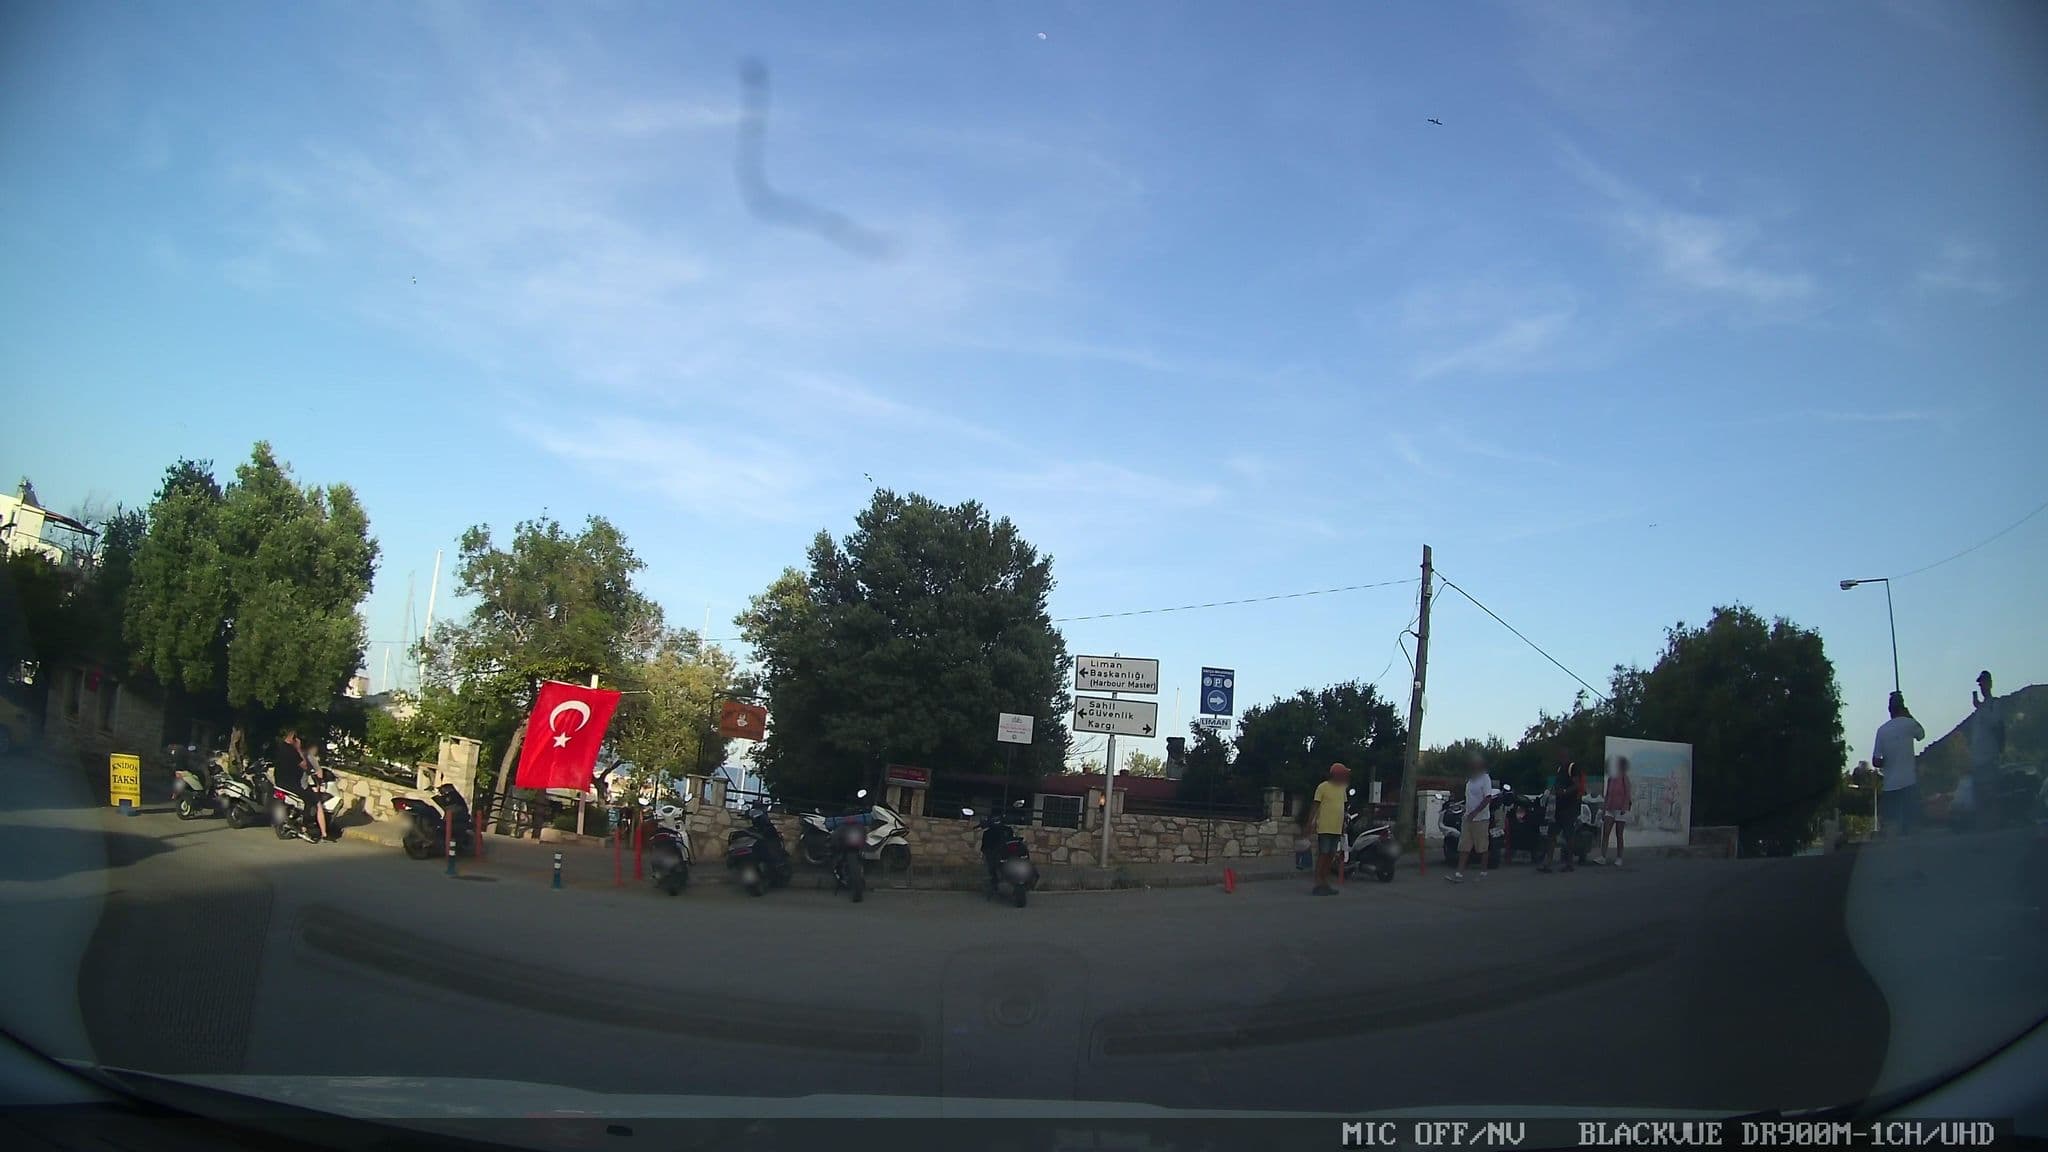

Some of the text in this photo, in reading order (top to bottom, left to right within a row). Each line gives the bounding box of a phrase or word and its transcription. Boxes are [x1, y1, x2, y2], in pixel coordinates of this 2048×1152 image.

[1090, 660, 1122, 669] Liman
[1090, 679, 1156, 691] (Harbour Master)
[1089, 701, 1116, 710] Sahil
[1088, 709, 1134, 720] Güvenlik
[1088, 720, 1115, 730] Kargı
